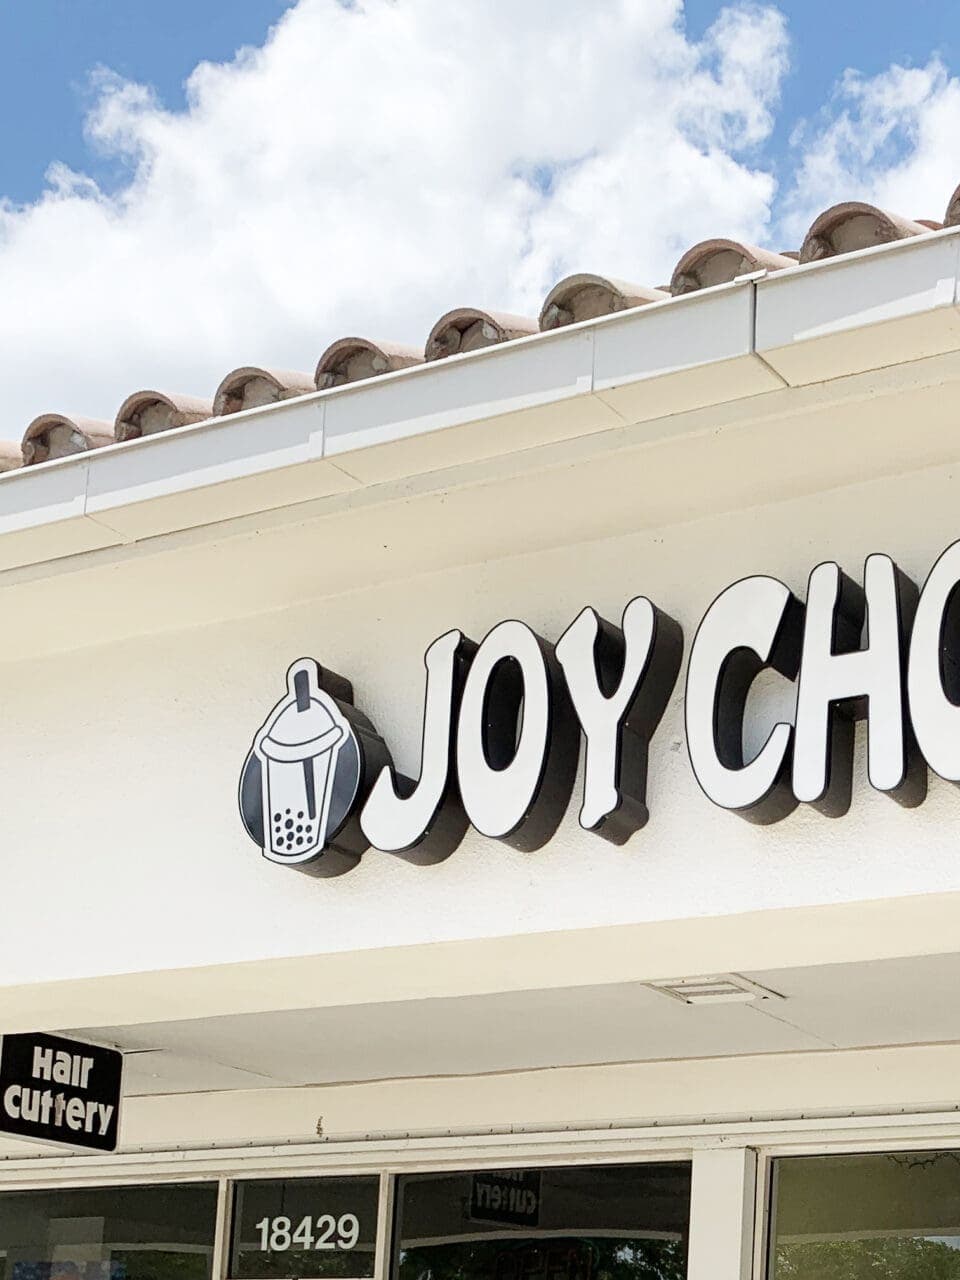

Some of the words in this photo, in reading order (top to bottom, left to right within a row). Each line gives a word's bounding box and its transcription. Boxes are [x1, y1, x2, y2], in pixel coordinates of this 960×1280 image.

[360, 595, 657, 852] JOY
[32, 1046, 94, 1089] Hair
[255, 1213, 360, 1251] 18429
